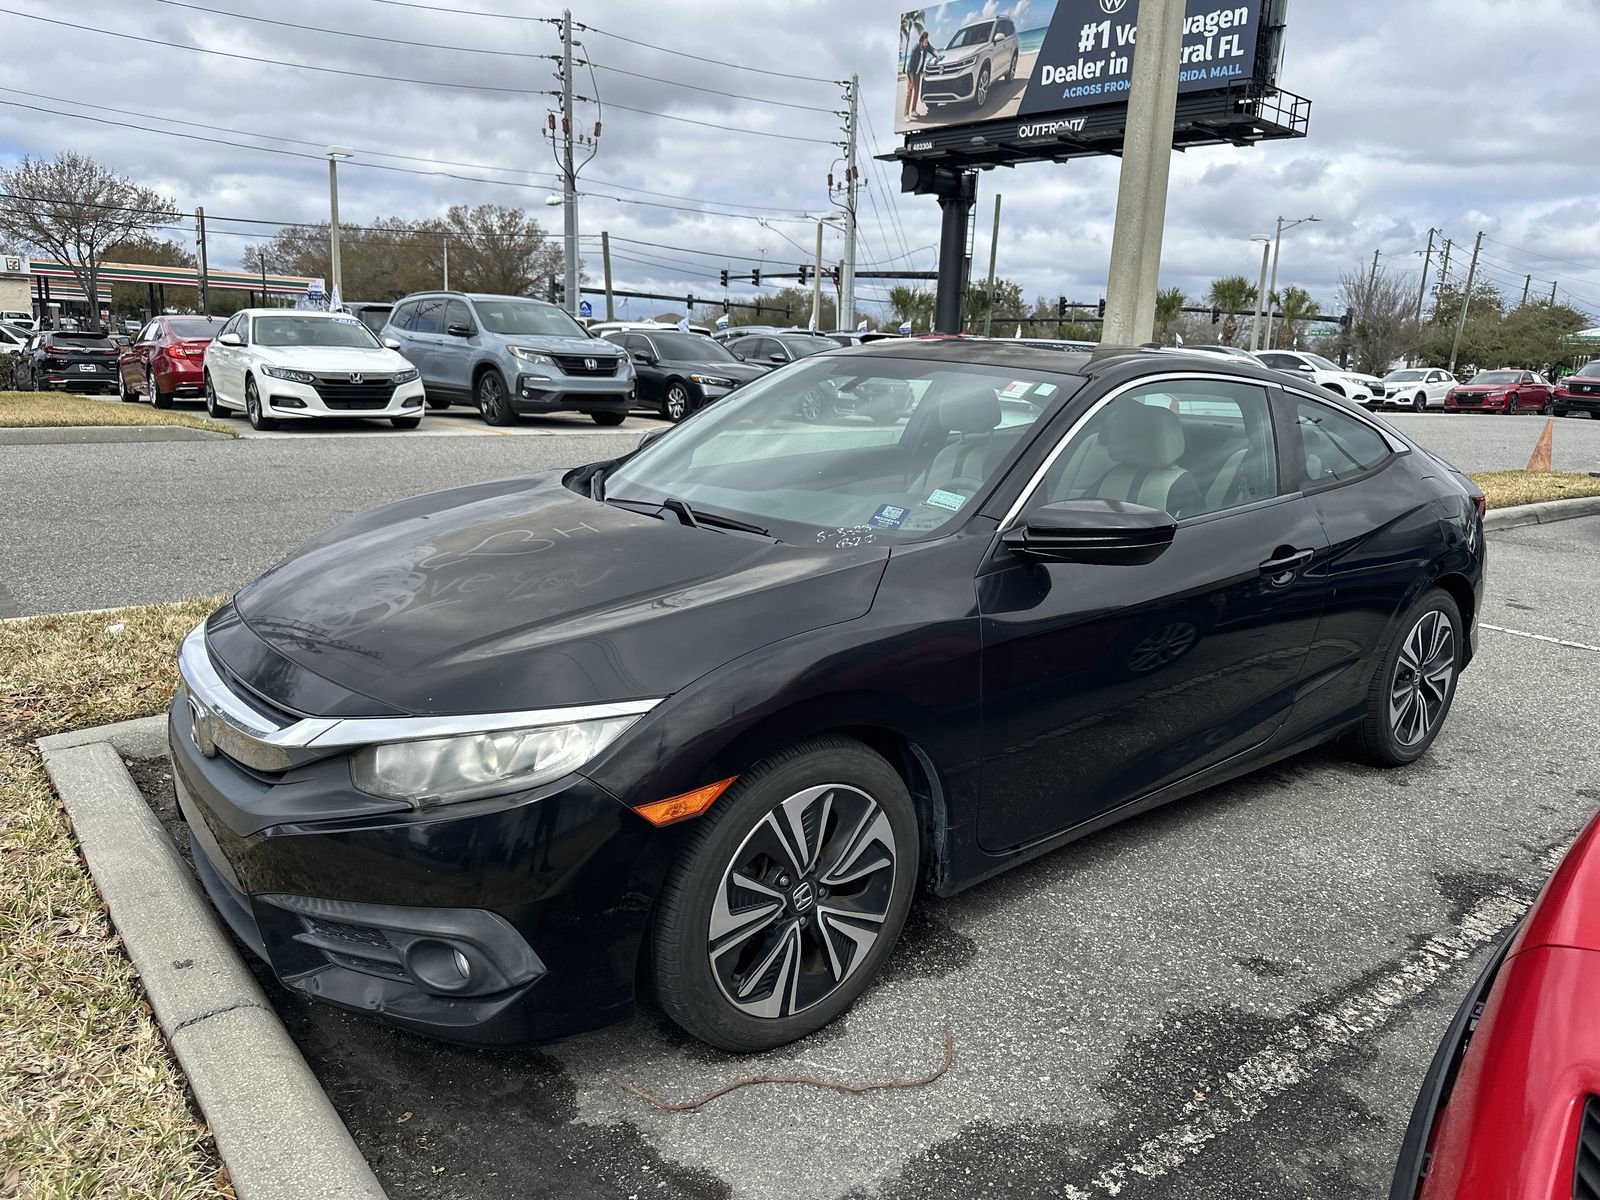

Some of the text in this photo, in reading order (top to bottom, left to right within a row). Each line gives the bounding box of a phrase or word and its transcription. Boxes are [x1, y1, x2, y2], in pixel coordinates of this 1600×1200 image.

[1078, 20, 1111, 52] #1
[1041, 58, 1105, 85] Dealer
[1109, 51, 1128, 75] in
[1218, 34, 1244, 59] FL
[1063, 84, 1102, 98] ACROSS
[1210, 64, 1242, 78] MALL
